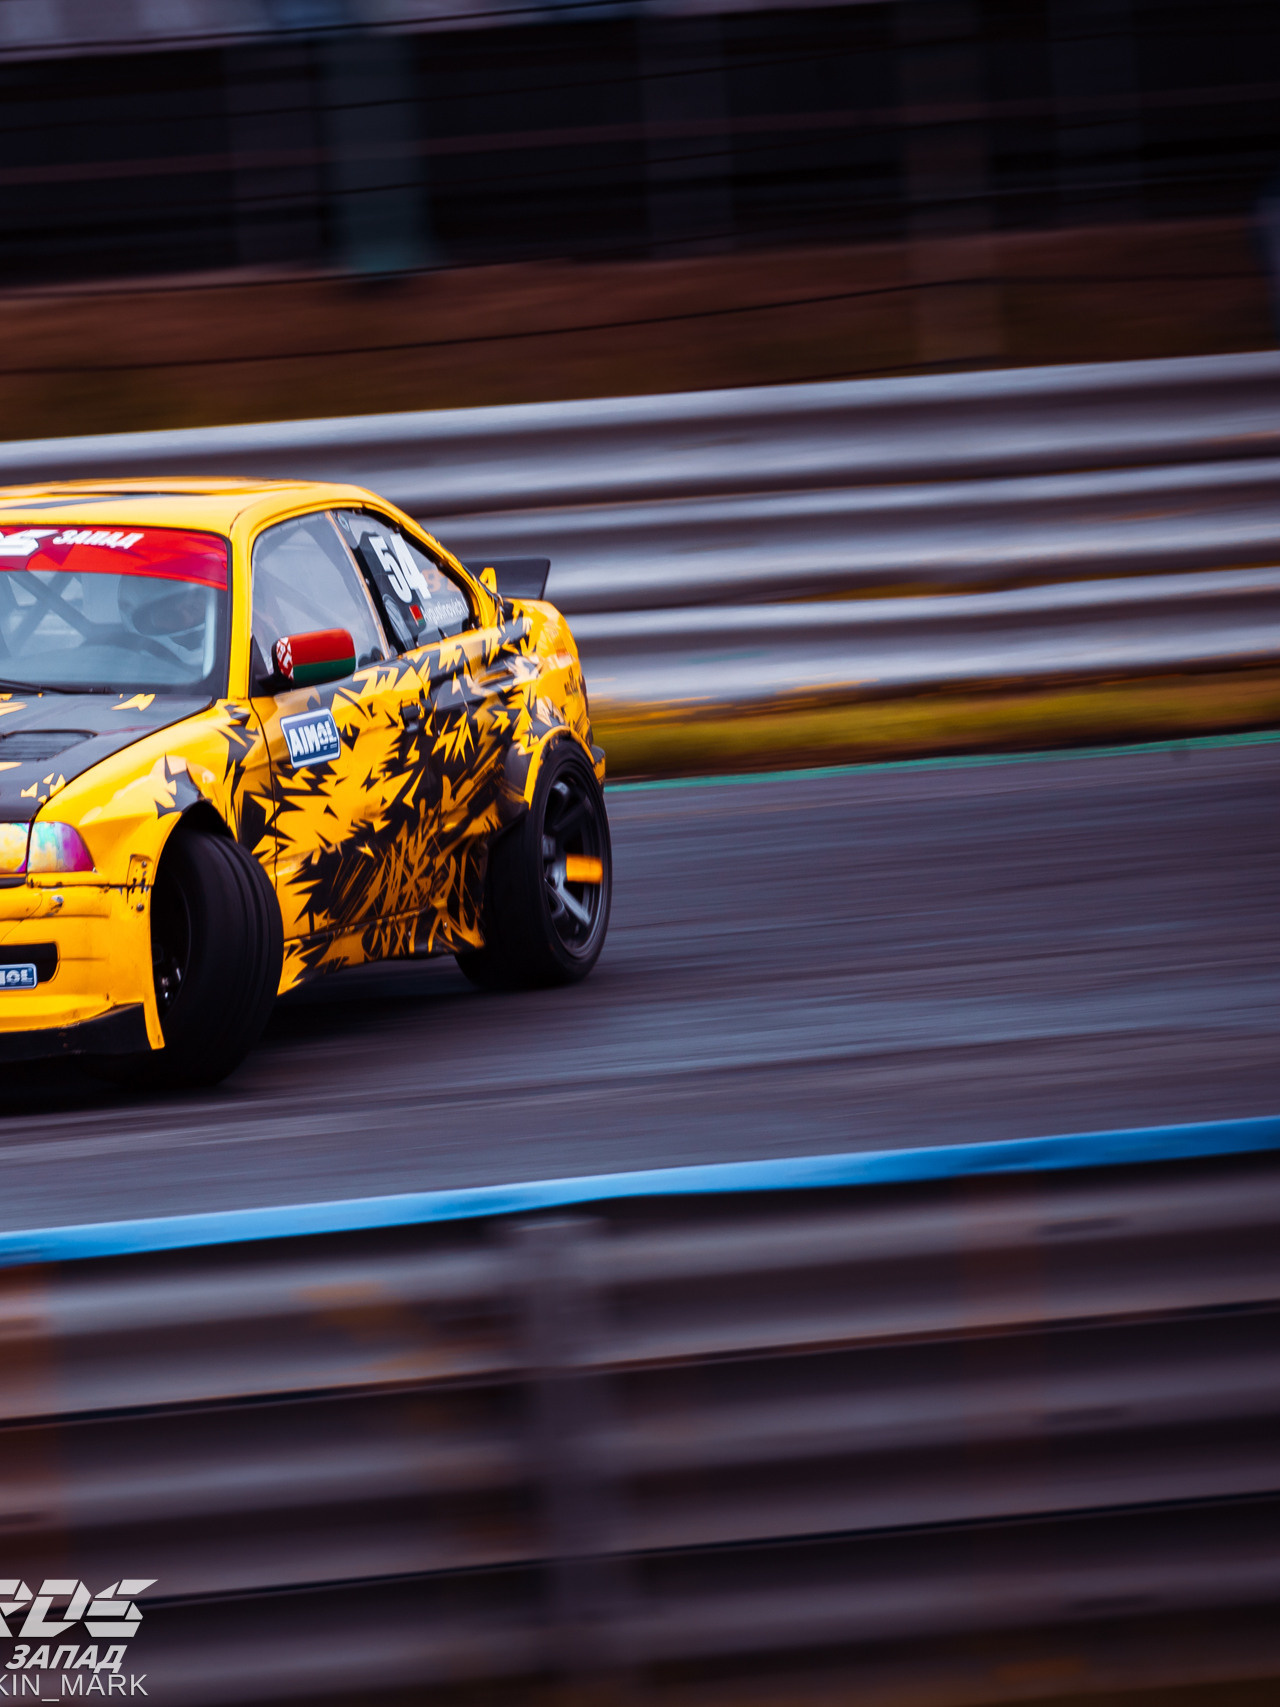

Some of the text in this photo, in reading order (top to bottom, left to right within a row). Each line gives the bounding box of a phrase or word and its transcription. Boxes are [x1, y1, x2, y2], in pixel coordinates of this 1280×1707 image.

[53, 530, 144, 549] ЗАПАД
[369, 532, 432, 603] 54
[289, 720, 337, 757] AIMOL
